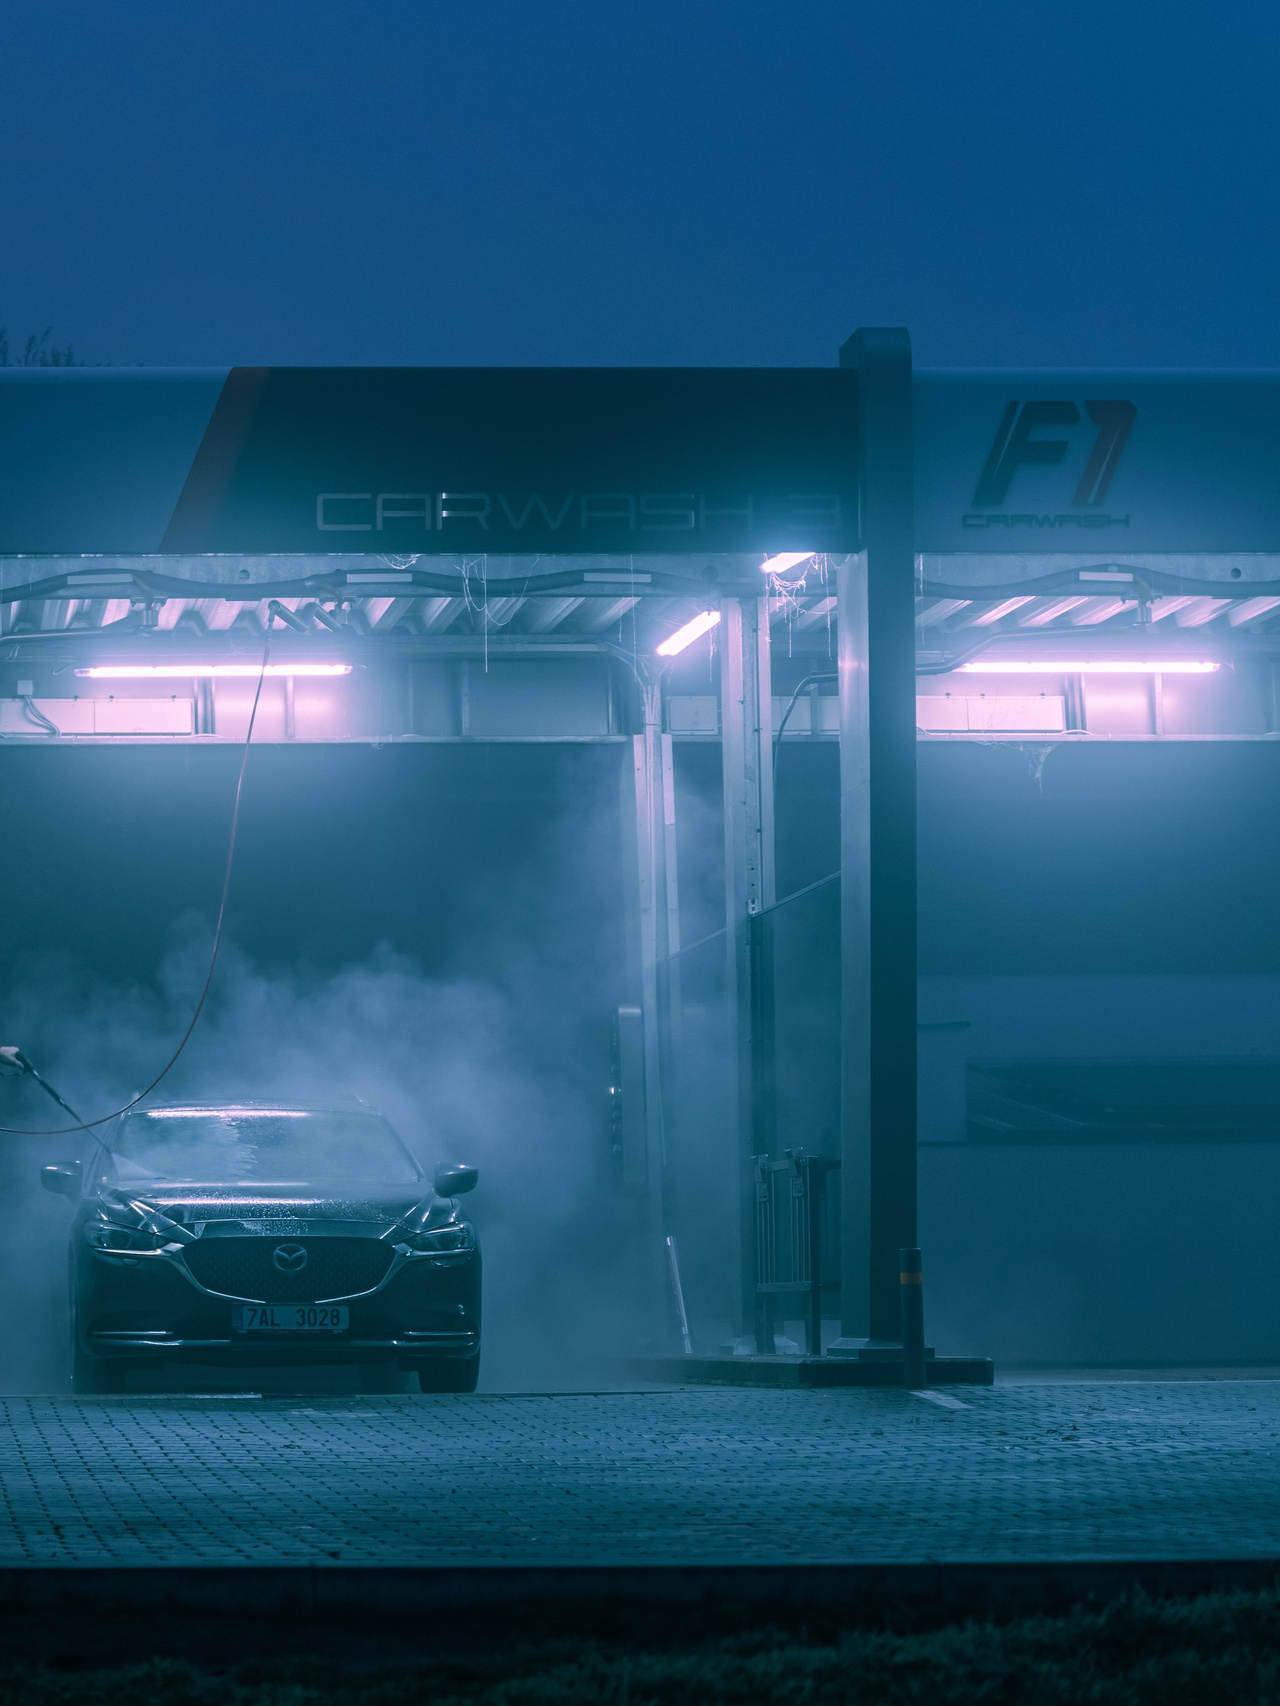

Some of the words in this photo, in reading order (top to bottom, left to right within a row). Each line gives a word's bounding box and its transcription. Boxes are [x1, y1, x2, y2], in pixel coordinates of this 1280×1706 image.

[970, 400, 1138, 506] F1
[316, 492, 754, 531] CARWASH
[962, 514, 1129, 528] CARWASH
[247, 1308, 280, 1326] 7AL
[296, 1308, 340, 1326] 3028
